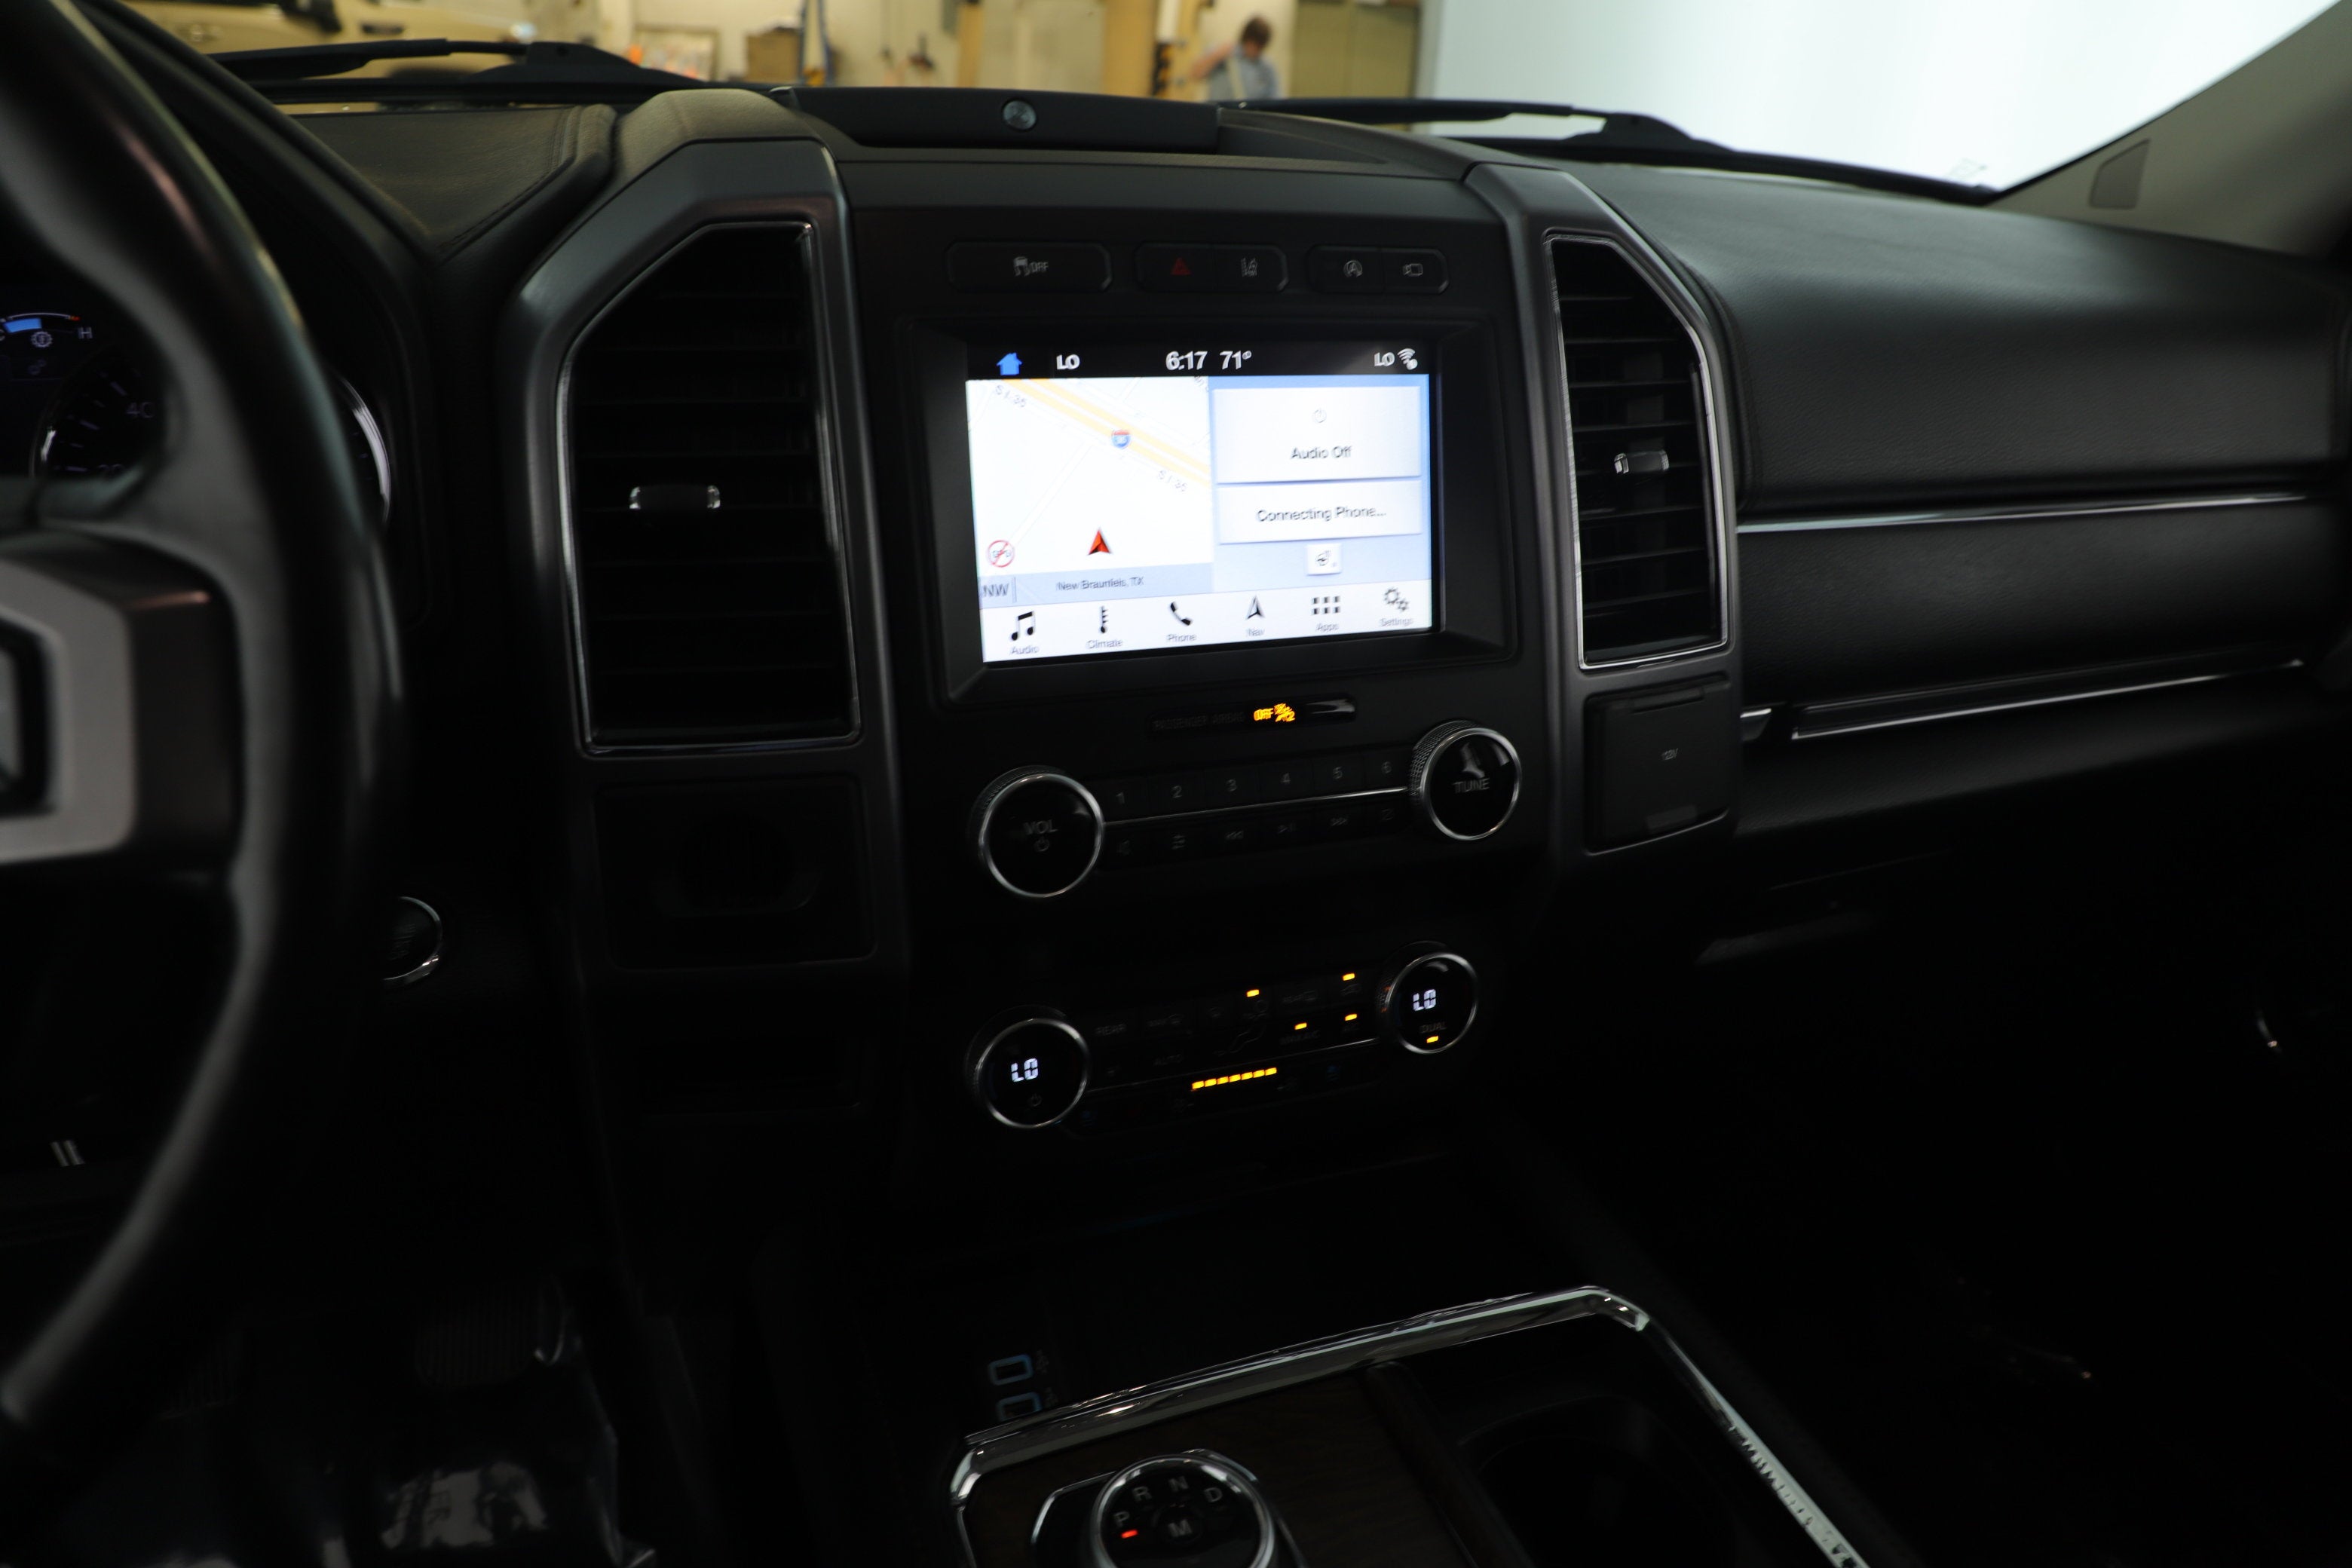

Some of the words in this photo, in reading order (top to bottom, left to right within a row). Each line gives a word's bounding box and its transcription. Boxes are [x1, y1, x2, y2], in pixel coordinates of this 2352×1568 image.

[78, 326, 93, 339] H
[1056, 354, 1080, 370] LO
[1165, 351, 1207, 371] 6:17
[1374, 351, 1395, 368] LO
[1291, 447, 1328, 459] Audio
[1332, 446, 1352, 458] Off
[1257, 508, 1332, 522] Connecting
[982, 583, 1009, 597] NW
[1056, 581, 1080, 590] New
[1129, 576, 1144, 586] TX
[1316, 623, 1339, 632] Apps
[1380, 617, 1414, 628] Settings
[1168, 633, 1197, 642] Phone
[1246, 627, 1265, 637] Nav
[1010, 645, 1040, 654] Audio
[1087, 639, 1123, 649] Climate
[1116, 792, 1125, 804] 1
[1171, 785, 1183, 798] 2
[1225, 779, 1237, 792] 3
[1281, 773, 1291, 785] 4
[1333, 767, 1344, 779] 5
[1381, 761, 1392, 774] 6
[1452, 777, 1490, 794] TUNE
[1021, 819, 1058, 836] VOL
[1413, 988, 1437, 1012] LO
[1010, 1057, 1040, 1083] LO
[1112, 1510, 1131, 1527] P
[1132, 1484, 1153, 1502] R
[1168, 1475, 1190, 1493] N
[1203, 1486, 1223, 1504] D
[1168, 1517, 1194, 1539] M
